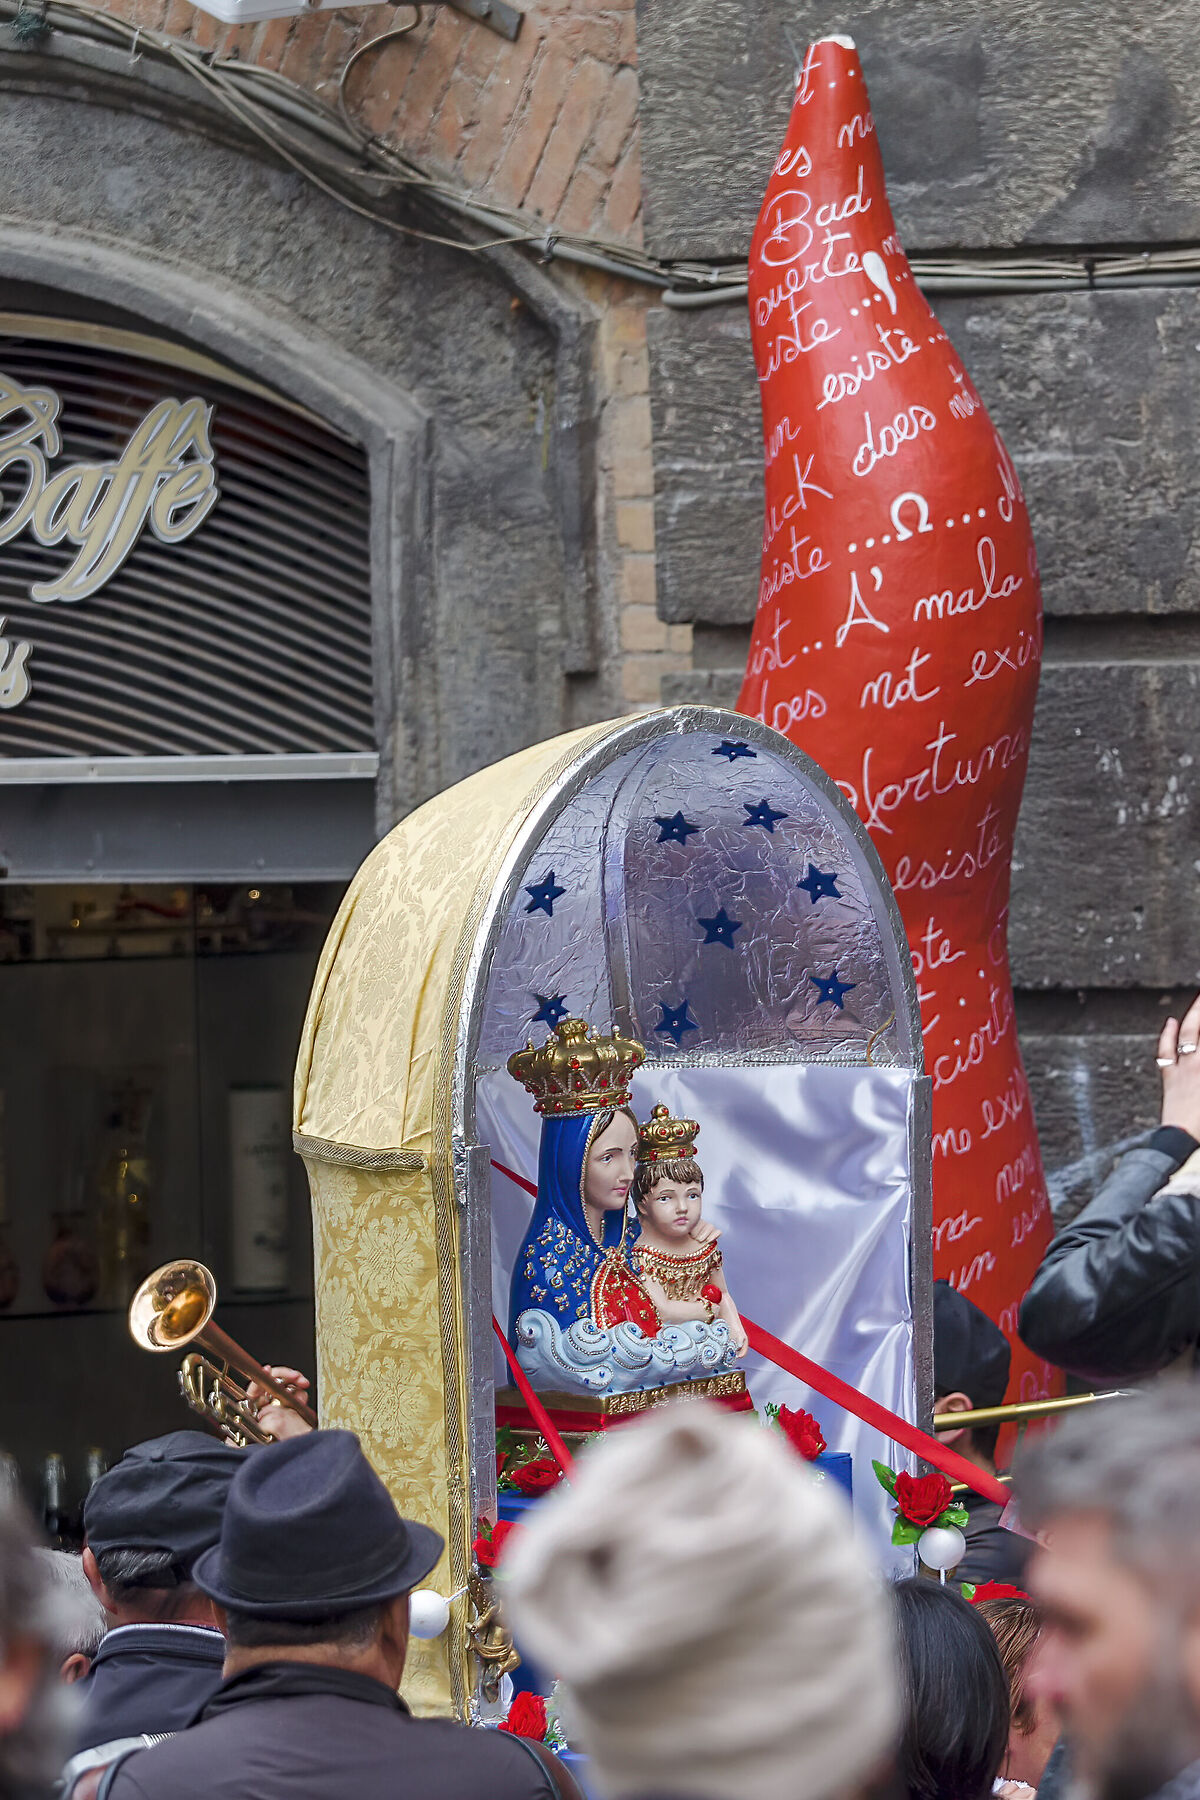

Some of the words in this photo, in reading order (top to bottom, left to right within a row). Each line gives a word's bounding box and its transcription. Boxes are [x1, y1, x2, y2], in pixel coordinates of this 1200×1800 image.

[760, 164, 872, 267] Bad
[852, 410, 937, 477] does
[913, 535, 1023, 623] mala
[859, 646, 941, 710] not
